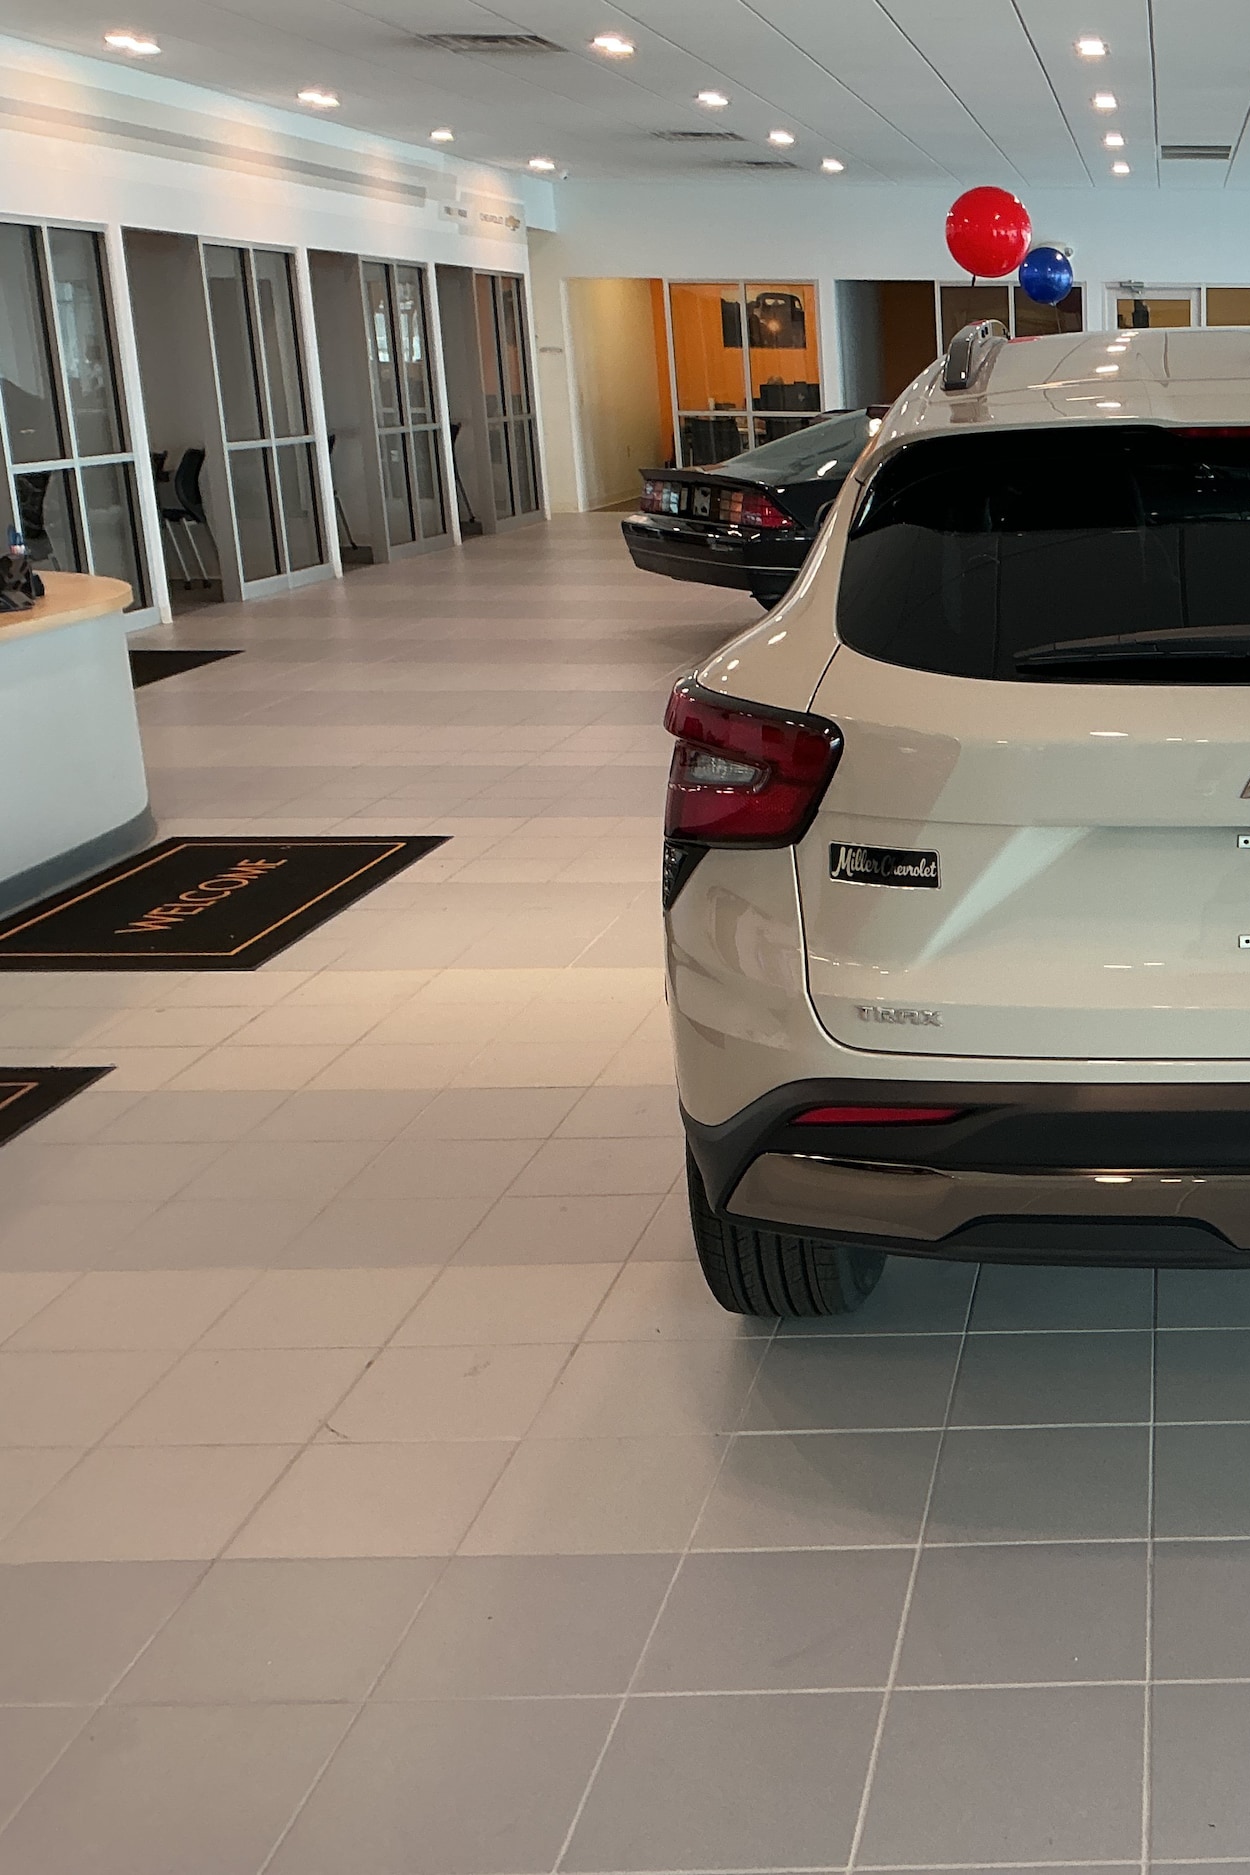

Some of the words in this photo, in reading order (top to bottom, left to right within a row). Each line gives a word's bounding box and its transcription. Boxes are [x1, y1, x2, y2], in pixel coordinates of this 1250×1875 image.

[831, 846, 880, 877] Miller
[114, 859, 288, 934] WELCOME
[856, 1005, 943, 1027] TRAX
